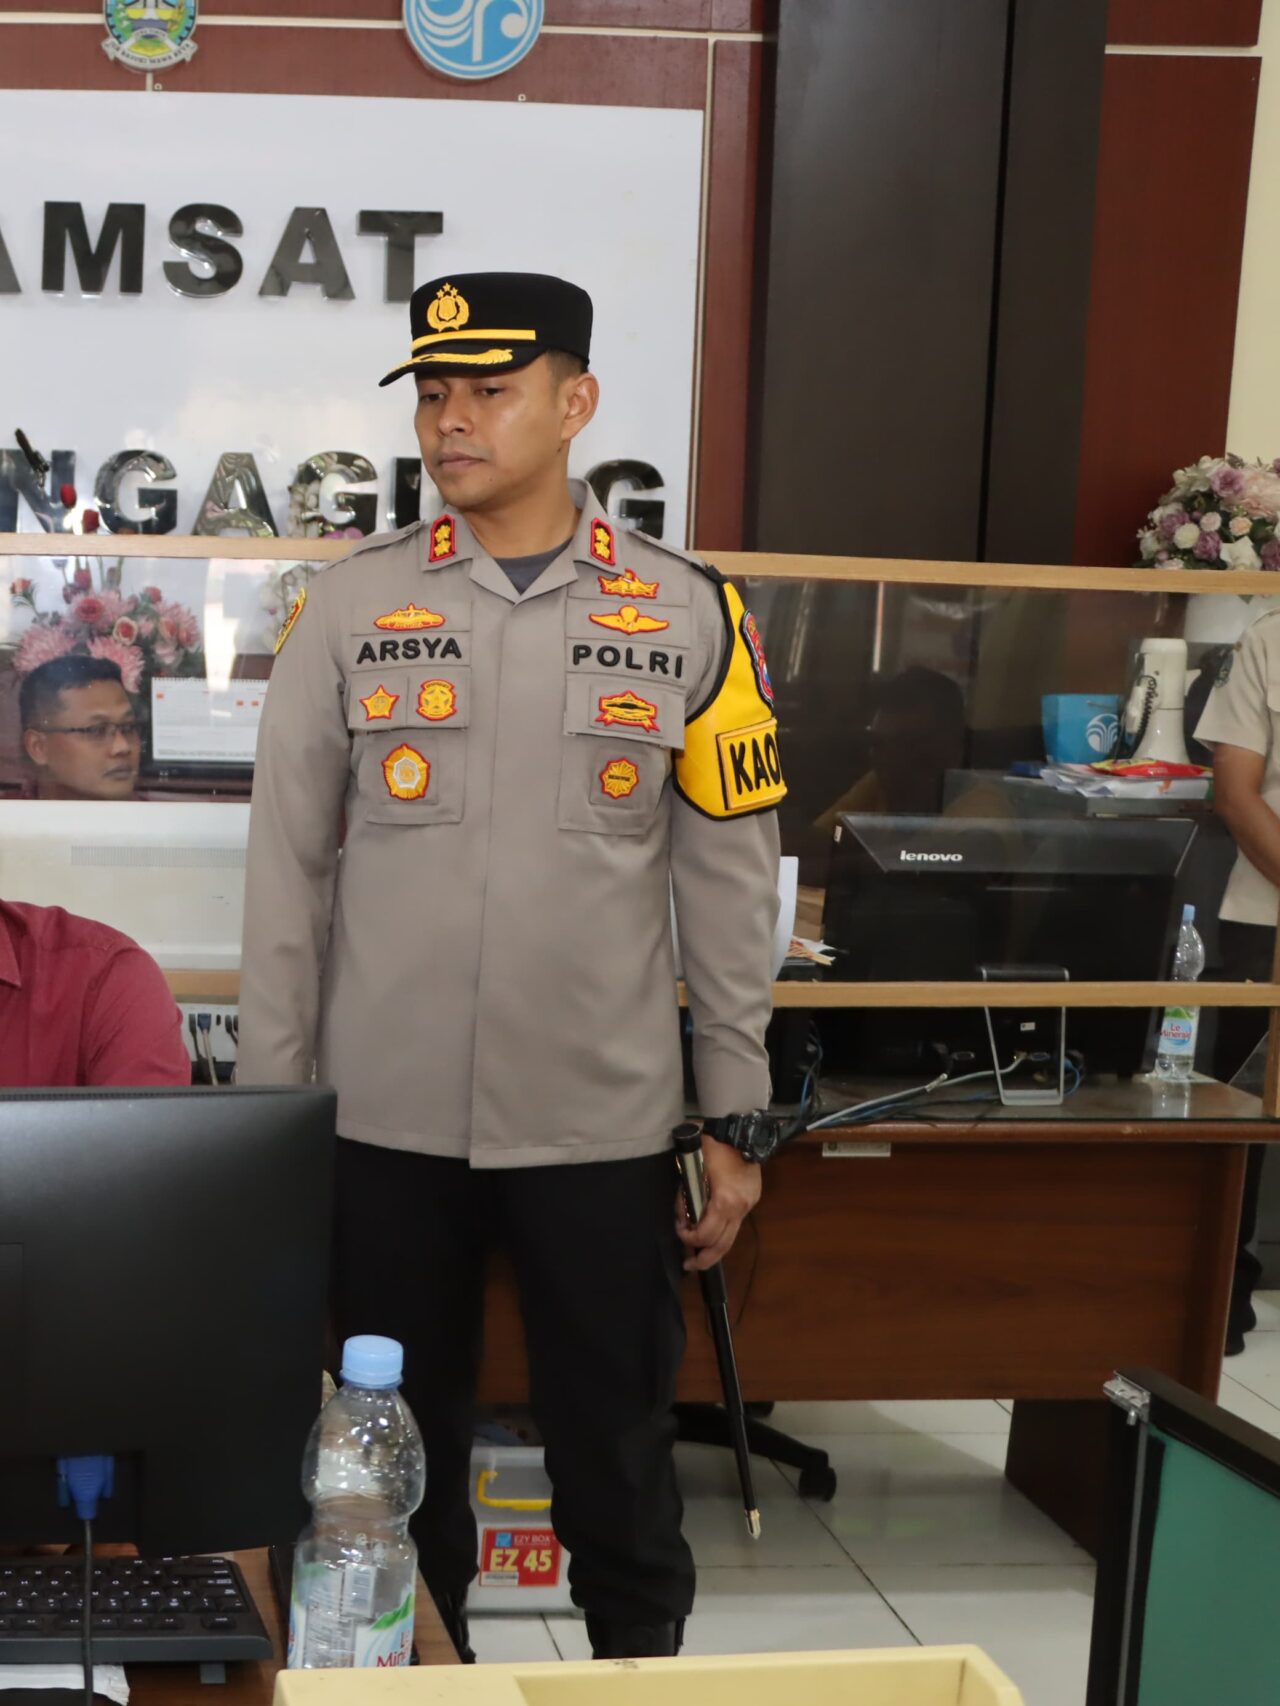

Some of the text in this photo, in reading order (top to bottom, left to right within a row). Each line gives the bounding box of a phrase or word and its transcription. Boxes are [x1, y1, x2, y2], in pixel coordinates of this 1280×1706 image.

[356, 637, 462, 664] ARSYA
[573, 644, 683, 678] POLRI
[729, 732, 782, 795] KAO
[900, 850, 963, 861] lenovo
[490, 1549, 552, 1572] EZ 45
